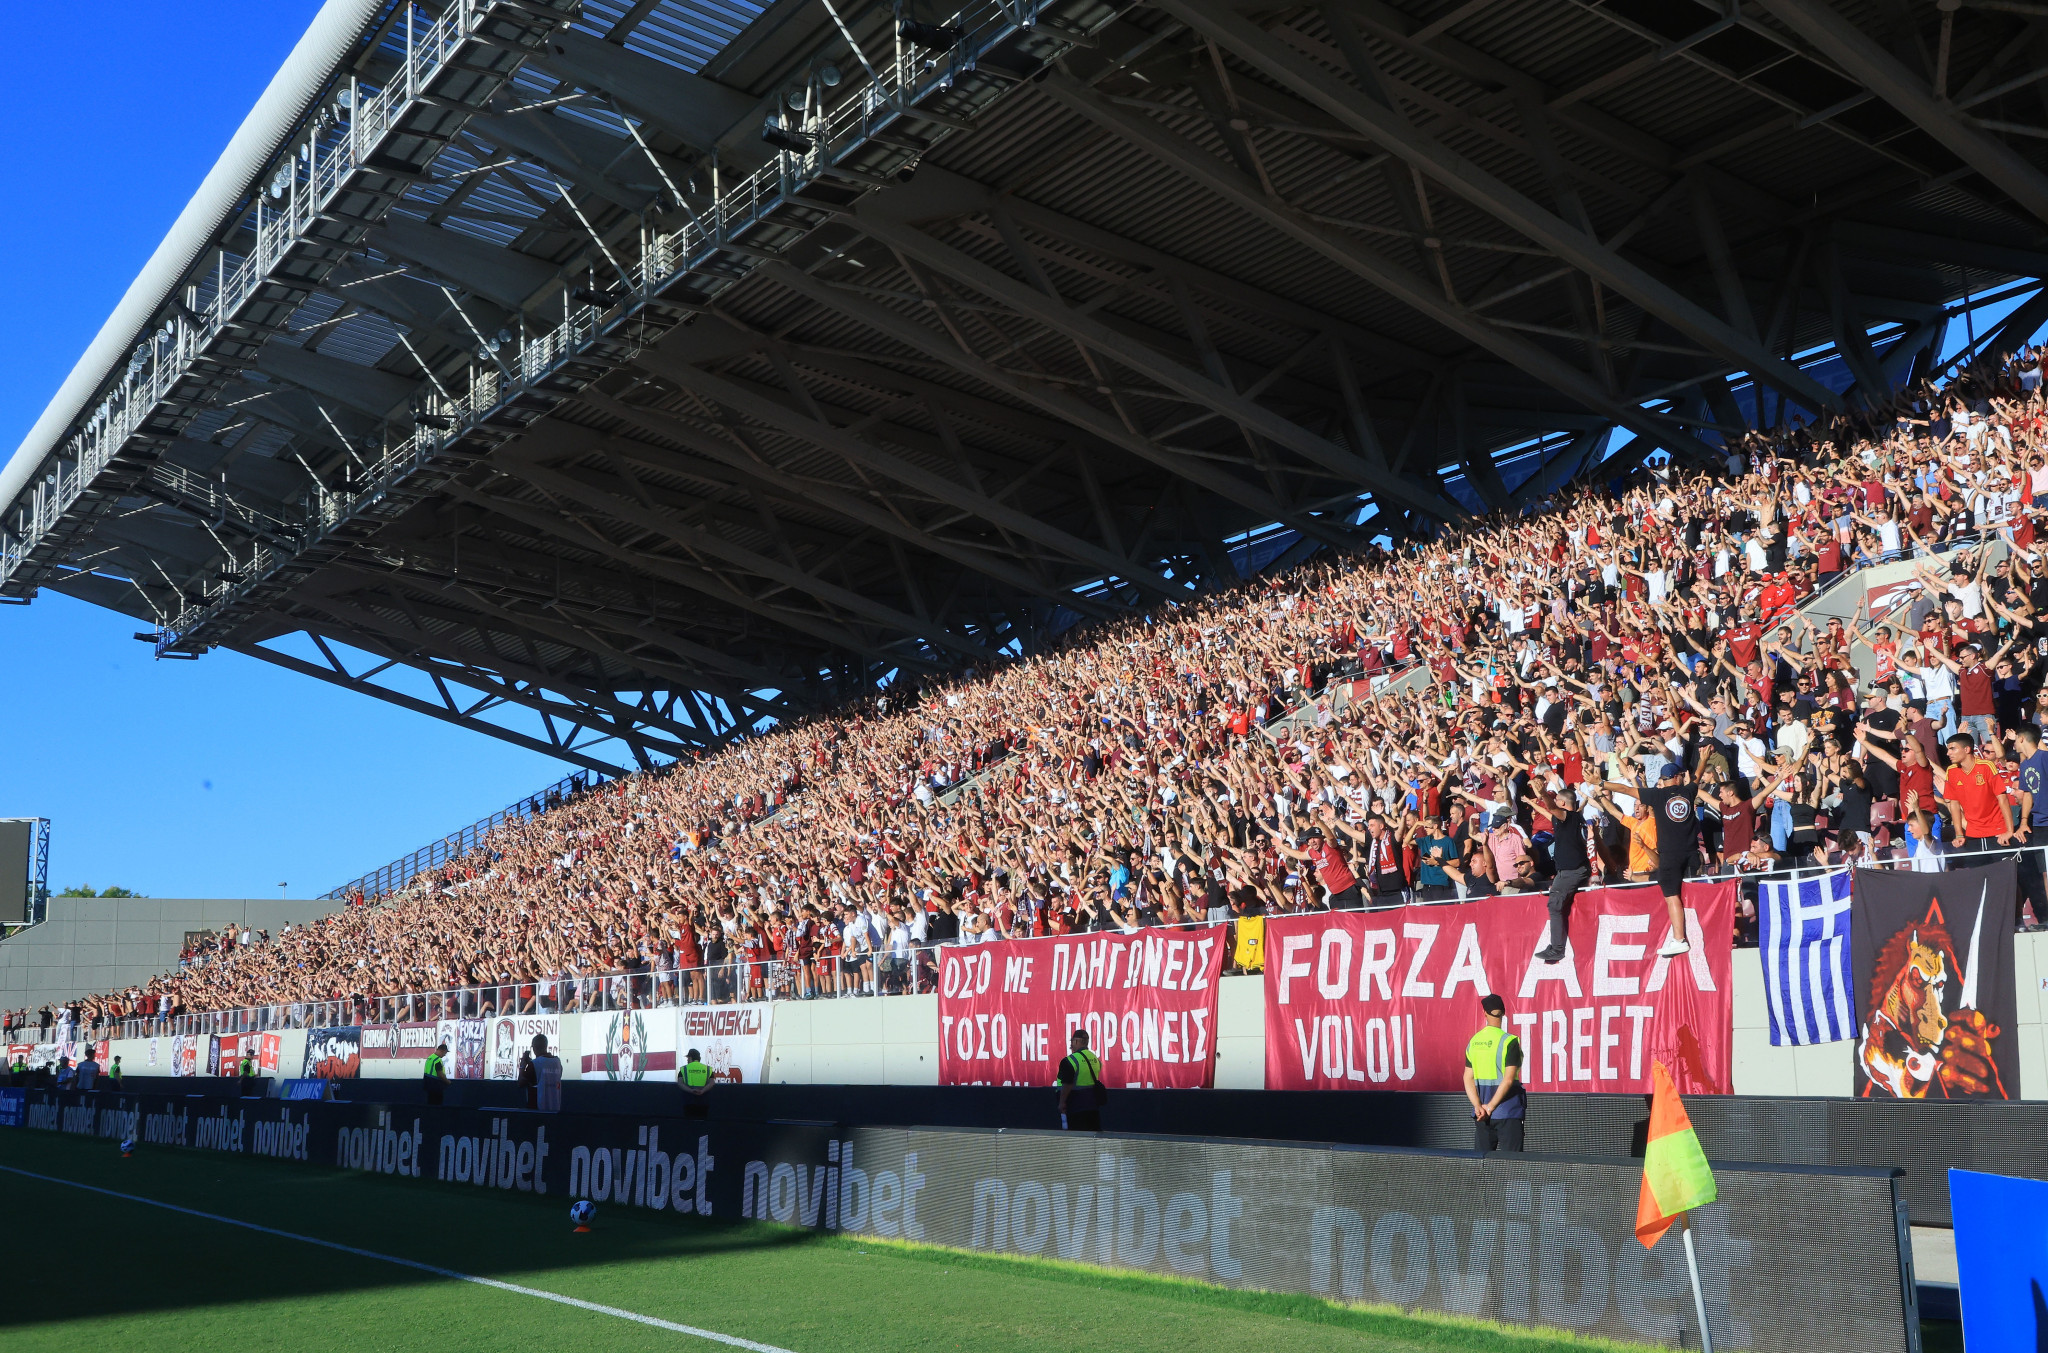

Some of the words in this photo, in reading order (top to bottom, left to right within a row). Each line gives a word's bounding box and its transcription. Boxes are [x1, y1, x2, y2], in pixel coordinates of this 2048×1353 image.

[943, 950, 992, 999] ΟΣΟ
[1004, 957, 1034, 994] ΜΕ
[1050, 935, 1214, 992] ΠΛΗΓΩΝΕΙΣ
[1277, 922, 1492, 1005] FORZA
[363, 1029, 387, 1048] CRIMSON
[400, 1028, 436, 1048] DEFENDERS
[460, 1020, 484, 1040] FORZA
[517, 1020, 558, 1035] VISSINI
[941, 1014, 1007, 1061] ΤΟΣΟ
[1021, 1023, 1049, 1062] ΜΕ
[1295, 1014, 1416, 1083] VOLOU
[1487, 1005, 1653, 1084] TREET
[145, 1101, 188, 1146] novibet
[195, 1105, 245, 1152] novibet
[253, 1107, 310, 1160] novibet
[337, 1111, 423, 1177] novibet
[438, 1117, 549, 1194] novibet
[569, 1125, 714, 1216] novibet
[742, 1139, 925, 1241] novibet
[972, 1153, 1243, 1278] novibet
[1309, 1179, 1752, 1350] novibet
